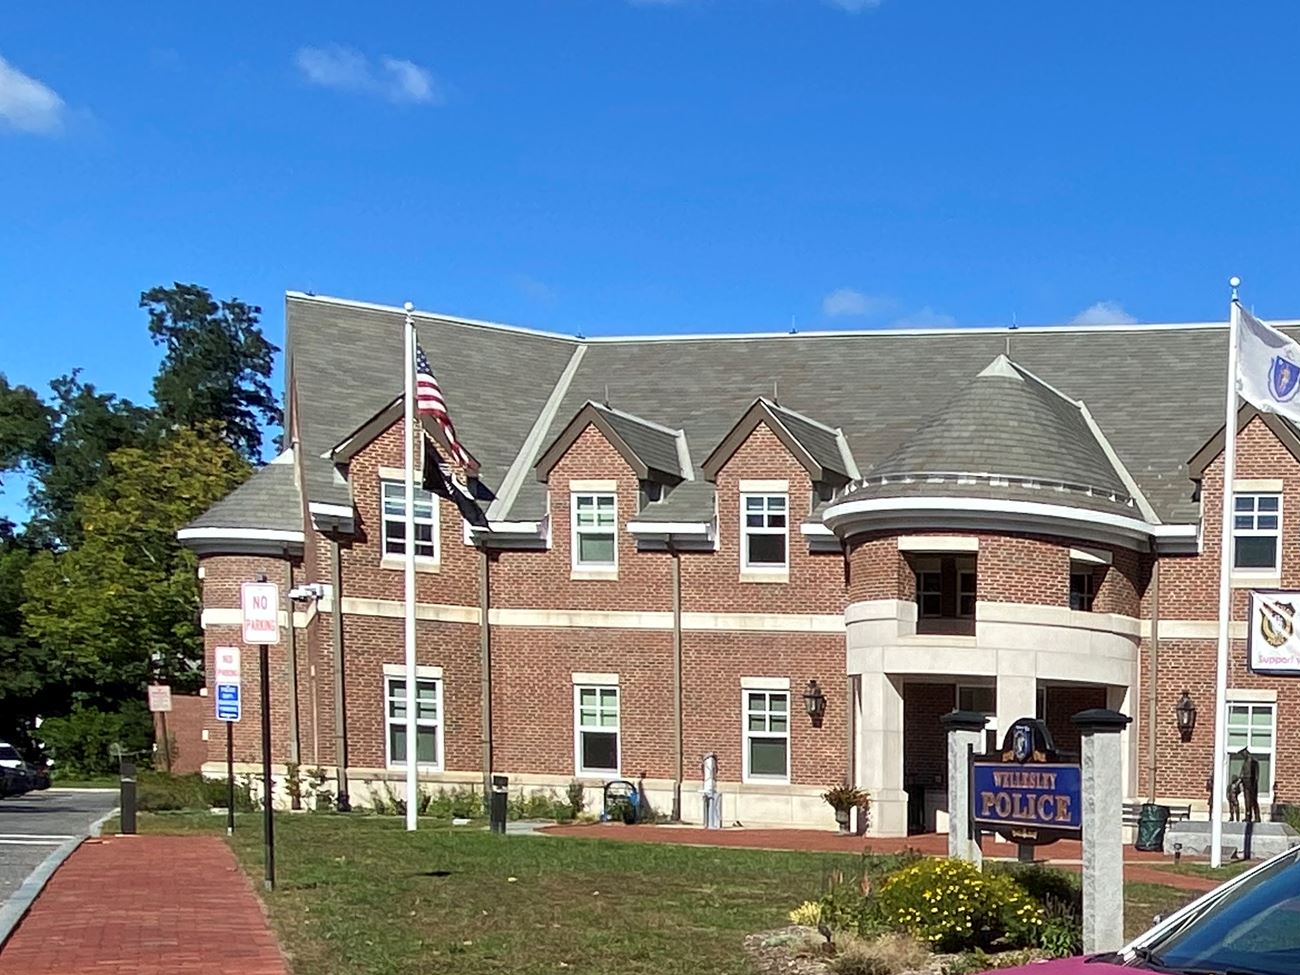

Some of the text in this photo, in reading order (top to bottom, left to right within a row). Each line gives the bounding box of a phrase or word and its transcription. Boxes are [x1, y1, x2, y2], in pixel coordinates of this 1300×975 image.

[253, 595, 268, 610] NO
[246, 619, 276, 631] PARKING
[1258, 655, 1294, 665] Support
[992, 771, 1058, 790] WELLESLEY
[981, 791, 1072, 822] POLICE
